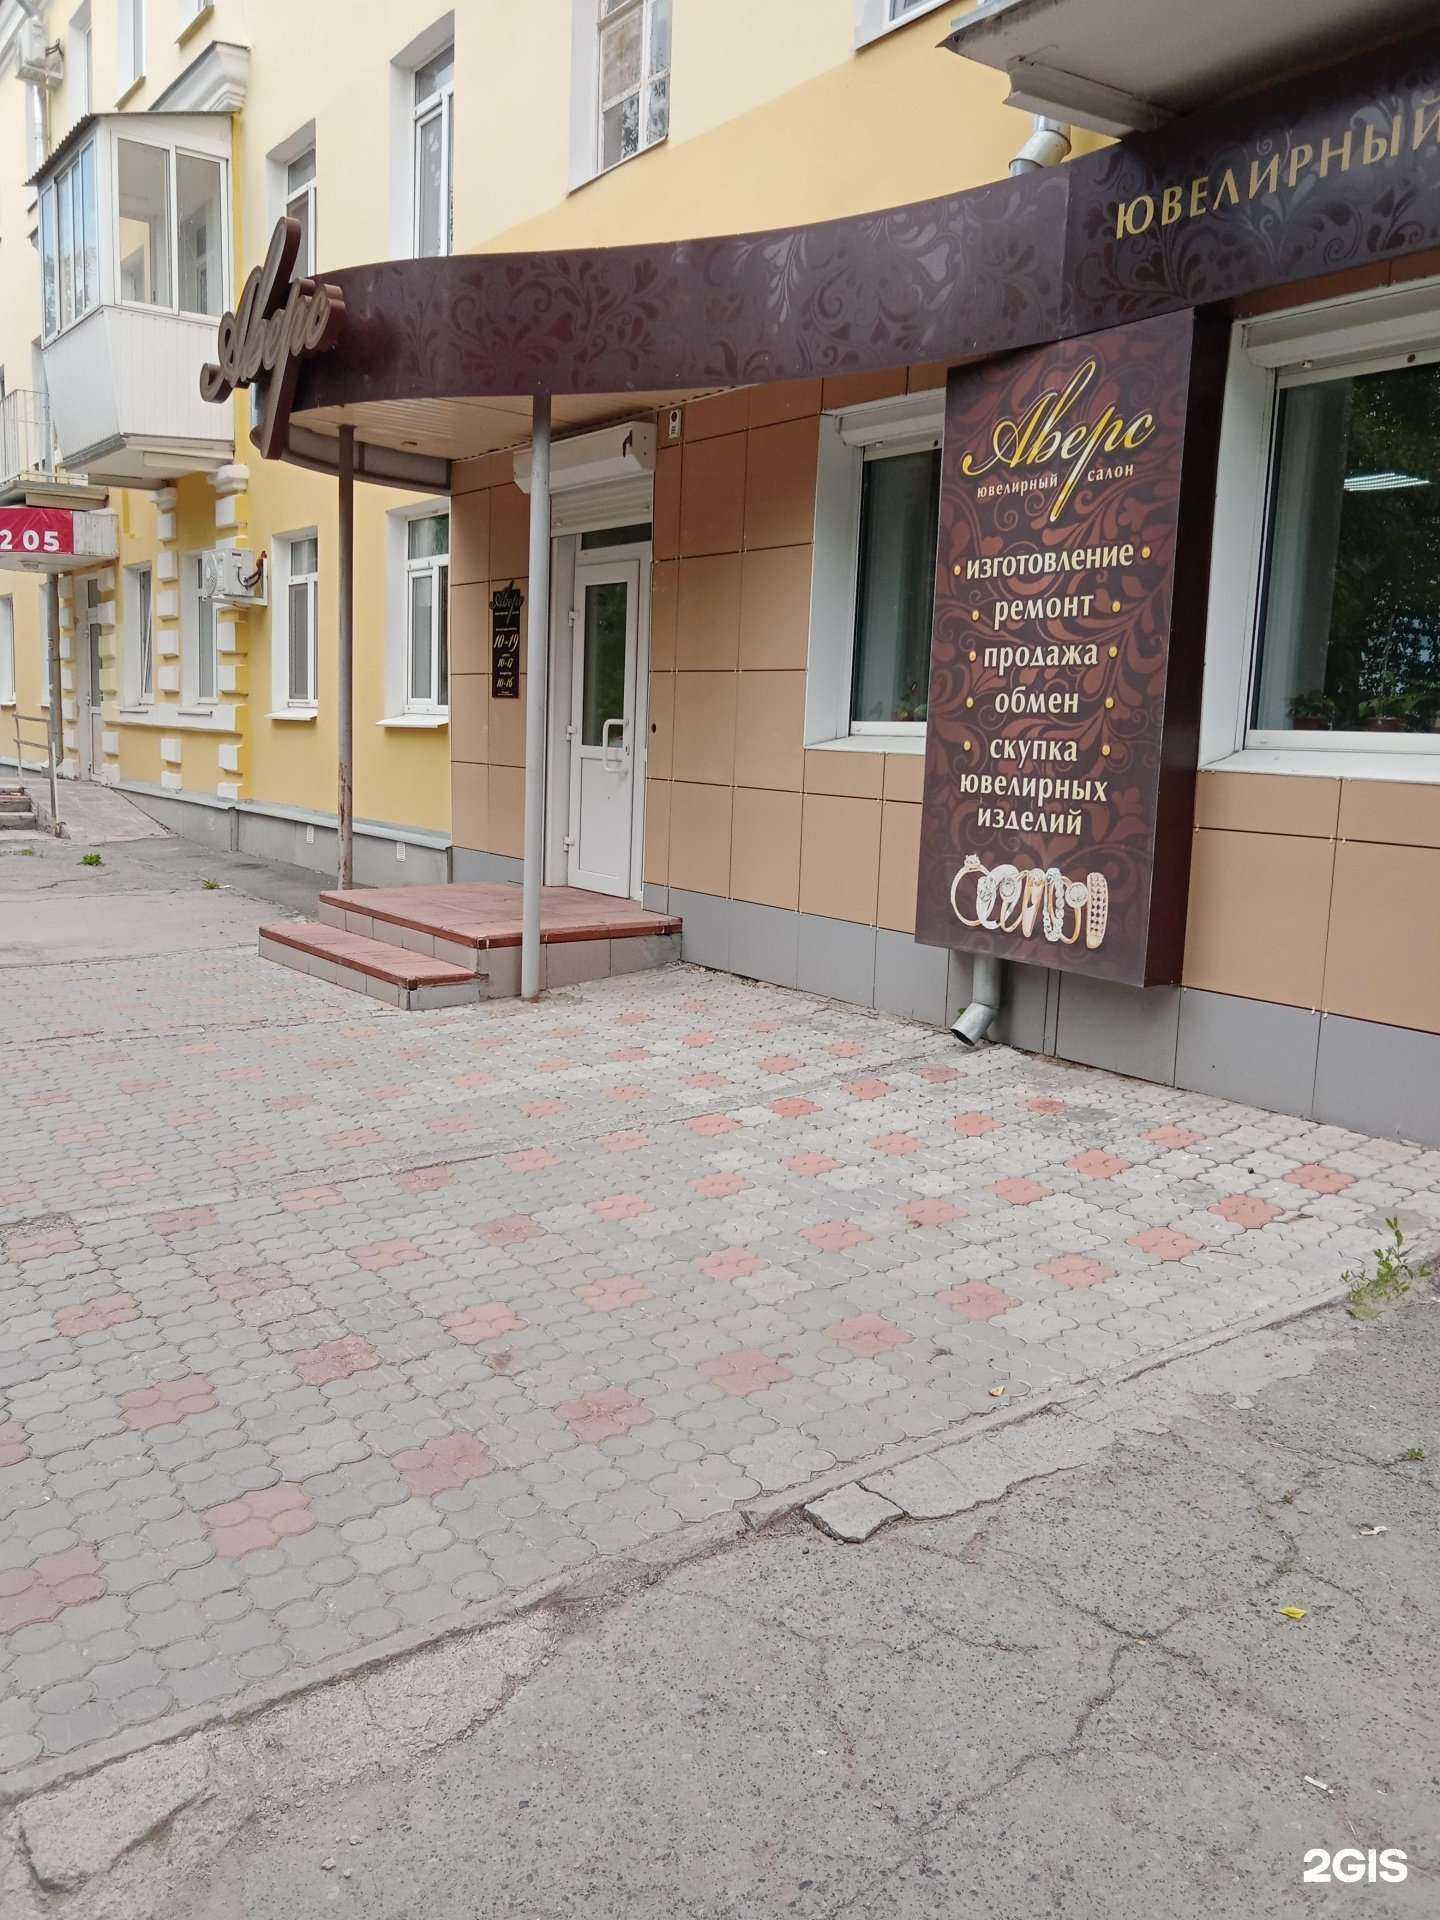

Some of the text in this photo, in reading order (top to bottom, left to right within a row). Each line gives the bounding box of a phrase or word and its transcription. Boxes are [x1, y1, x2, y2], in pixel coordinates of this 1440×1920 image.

[1115, 97, 1440, 240] ЮВЕЛИРНЫЙ
[961, 356, 1155, 522] Аверс
[977, 463, 1134, 499] ювелирный салон
[966, 543, 1134, 580] изготовление
[994, 595, 1094, 631] ремонт
[983, 643, 1098, 676] продажа
[994, 686, 1079, 714] обмен
[989, 737, 1078, 768] скупка
[960, 773, 1108, 807] ювелирных
[977, 807, 1082, 836] изделий
